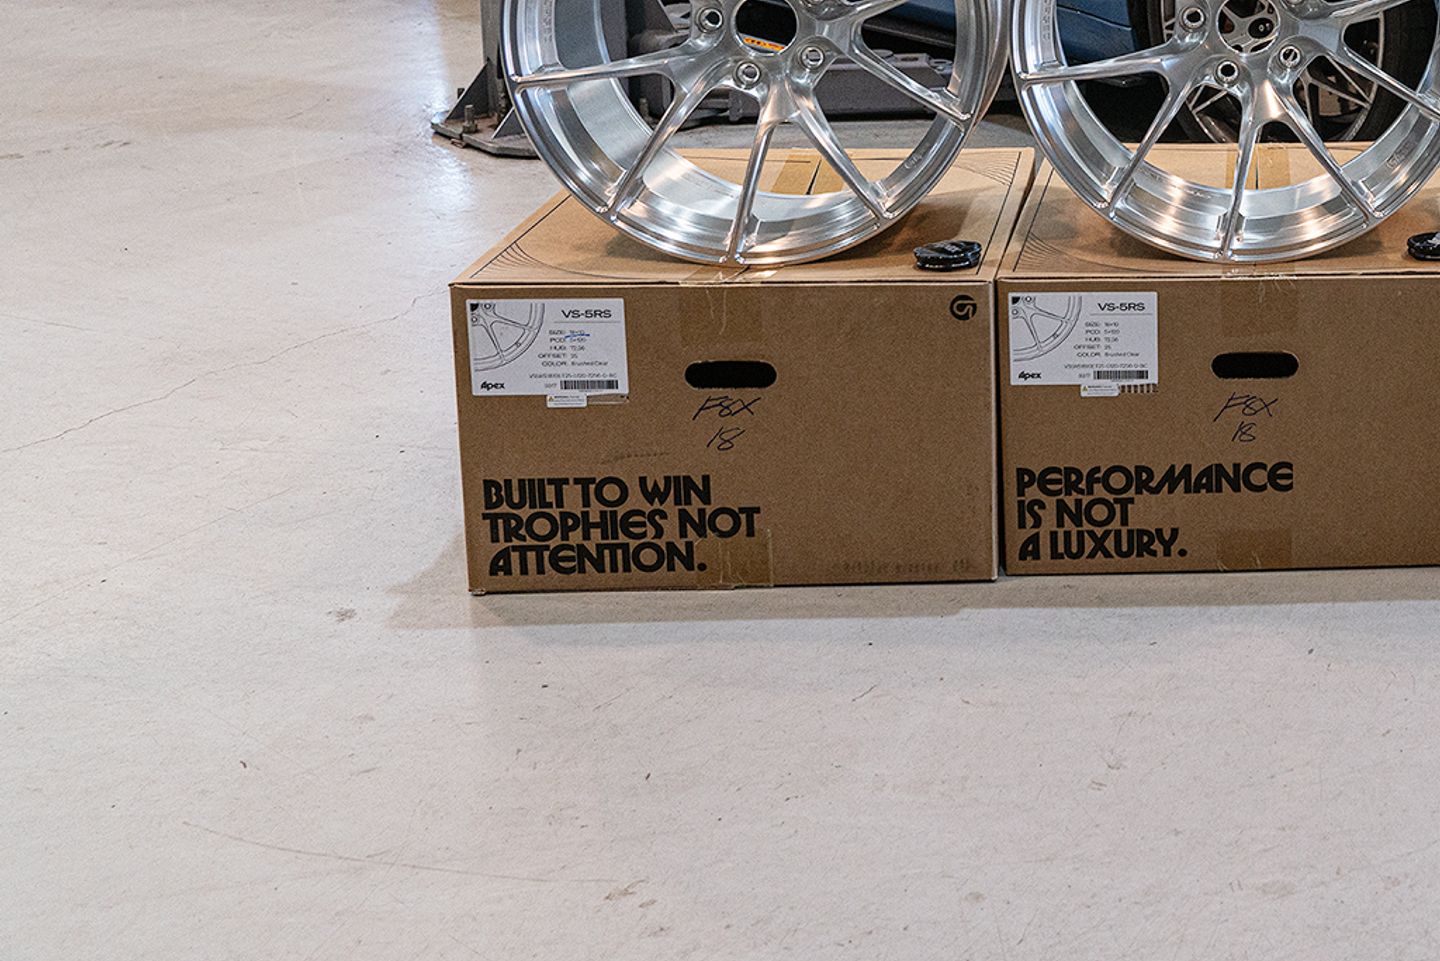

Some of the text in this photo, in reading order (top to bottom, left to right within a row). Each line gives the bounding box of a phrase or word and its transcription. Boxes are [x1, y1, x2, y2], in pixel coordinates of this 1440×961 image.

[561, 309, 612, 319] VS-5RS
[1098, 302, 1145, 312] VS-5RS
[481, 381, 505, 391] Apex
[1018, 369, 1041, 380] Apex
[706, 427, 745, 451] 18
[1231, 421, 1257, 443] 18
[482, 474, 712, 510] BUILT TO WIN
[1016, 461, 1294, 498] PERFORMANCE
[482, 506, 761, 542] TROPHIES NOT
[1017, 497, 1135, 530] IS NOT
[489, 540, 708, 577] ATTENTION.
[1018, 528, 1188, 561] A LUXURY.
